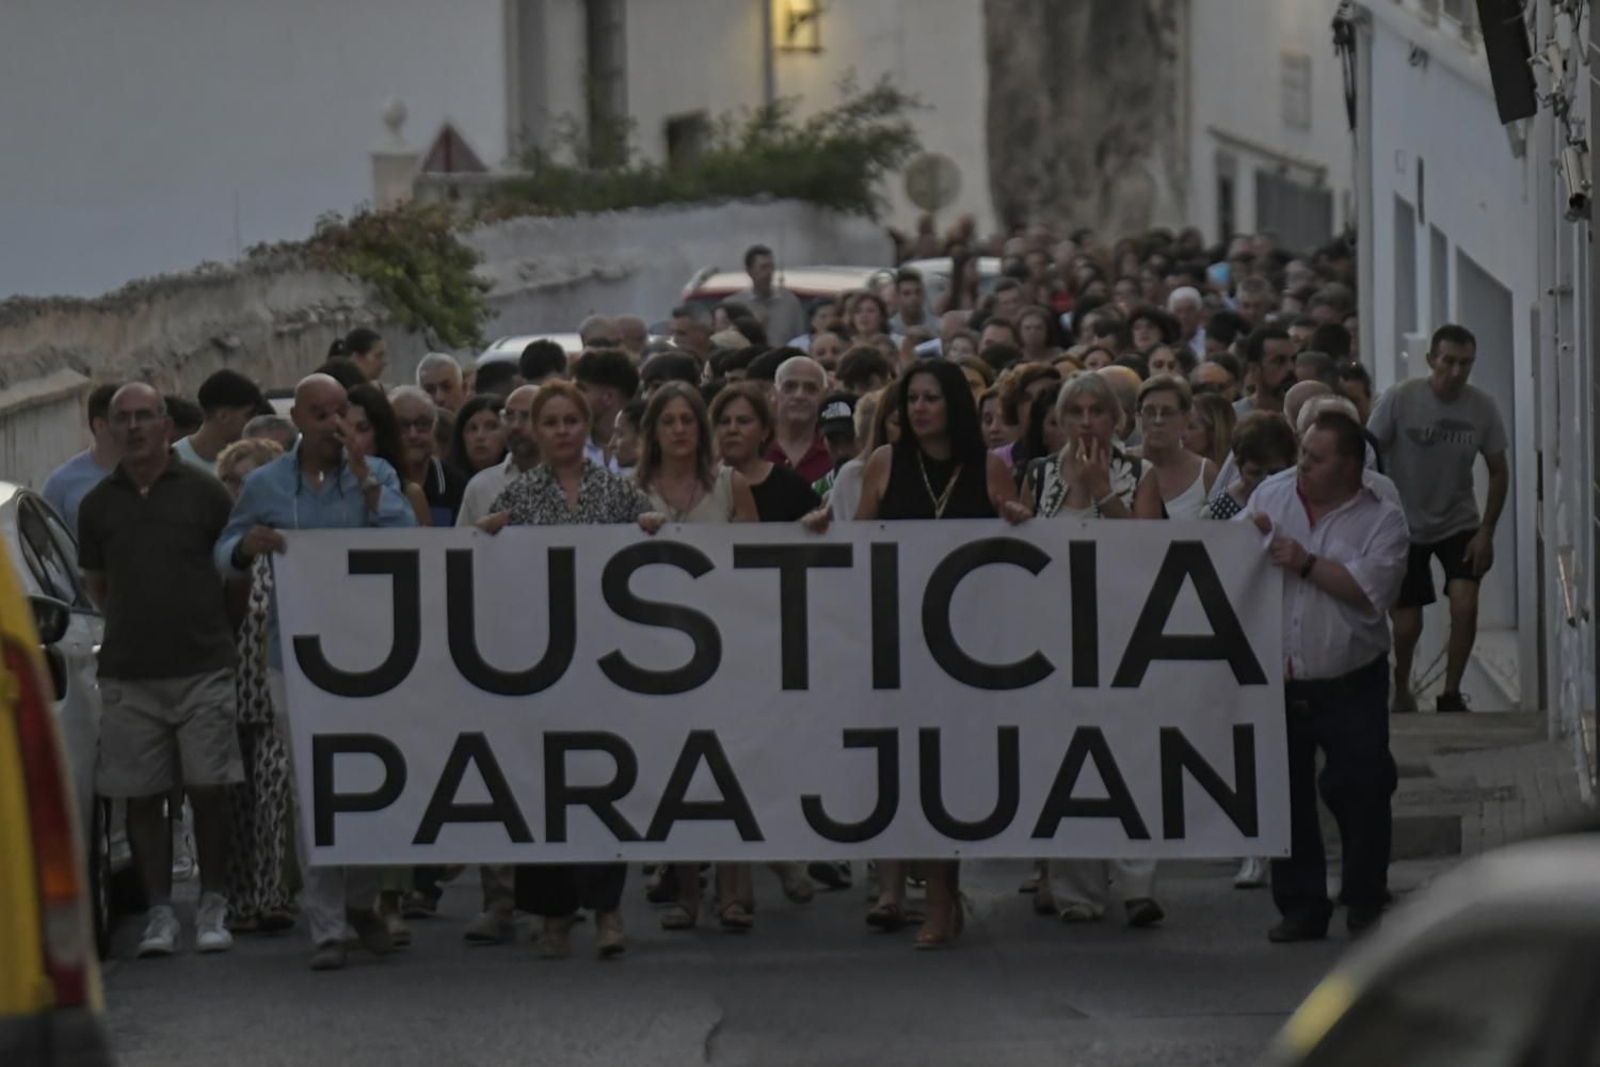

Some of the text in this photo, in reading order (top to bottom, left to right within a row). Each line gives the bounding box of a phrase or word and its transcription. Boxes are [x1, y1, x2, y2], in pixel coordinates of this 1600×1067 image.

[292, 536, 1269, 699] JUSTICIA
[312, 722, 1260, 849] PARA JUAN
